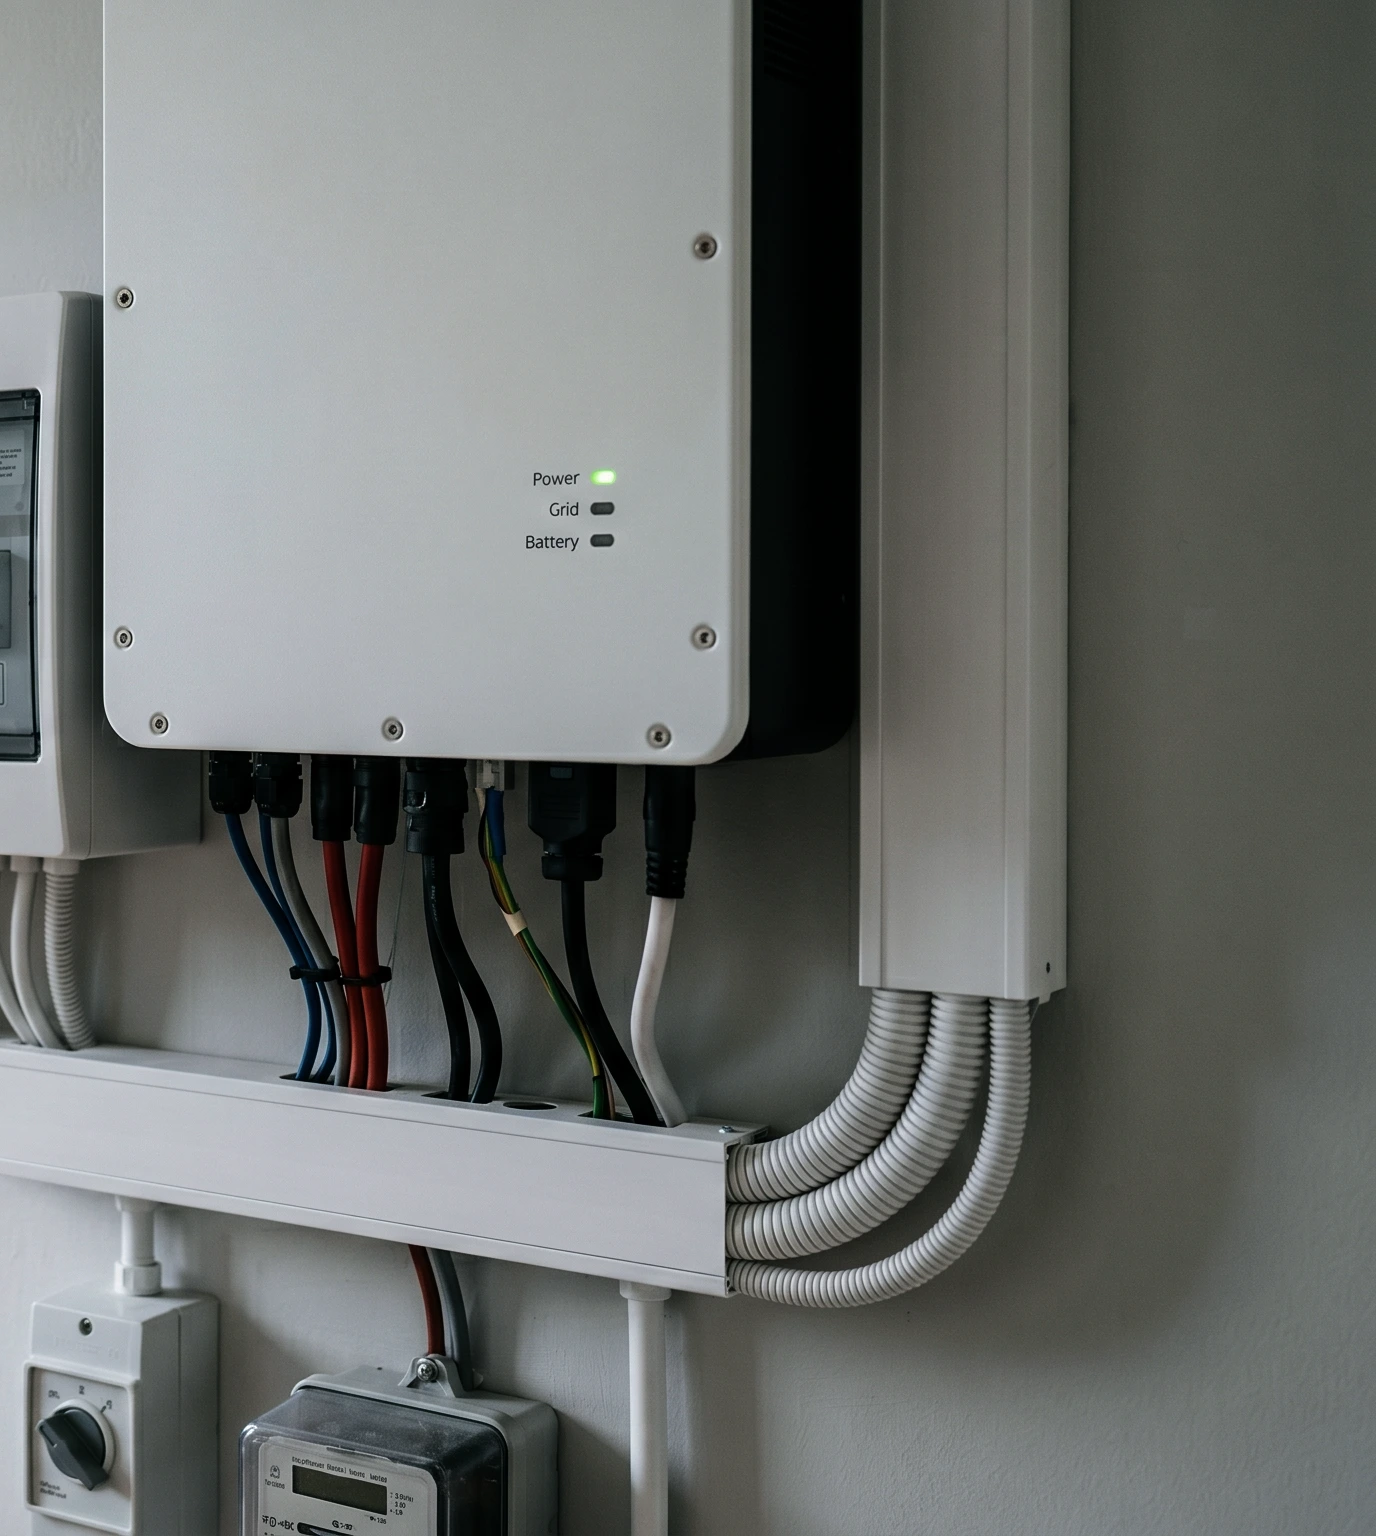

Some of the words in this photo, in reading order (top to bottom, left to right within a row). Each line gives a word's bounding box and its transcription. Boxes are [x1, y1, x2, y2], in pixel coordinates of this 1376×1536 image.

[533, 472, 580, 486] Power
[549, 501, 579, 516] Grid
[525, 535, 579, 552] Battery
